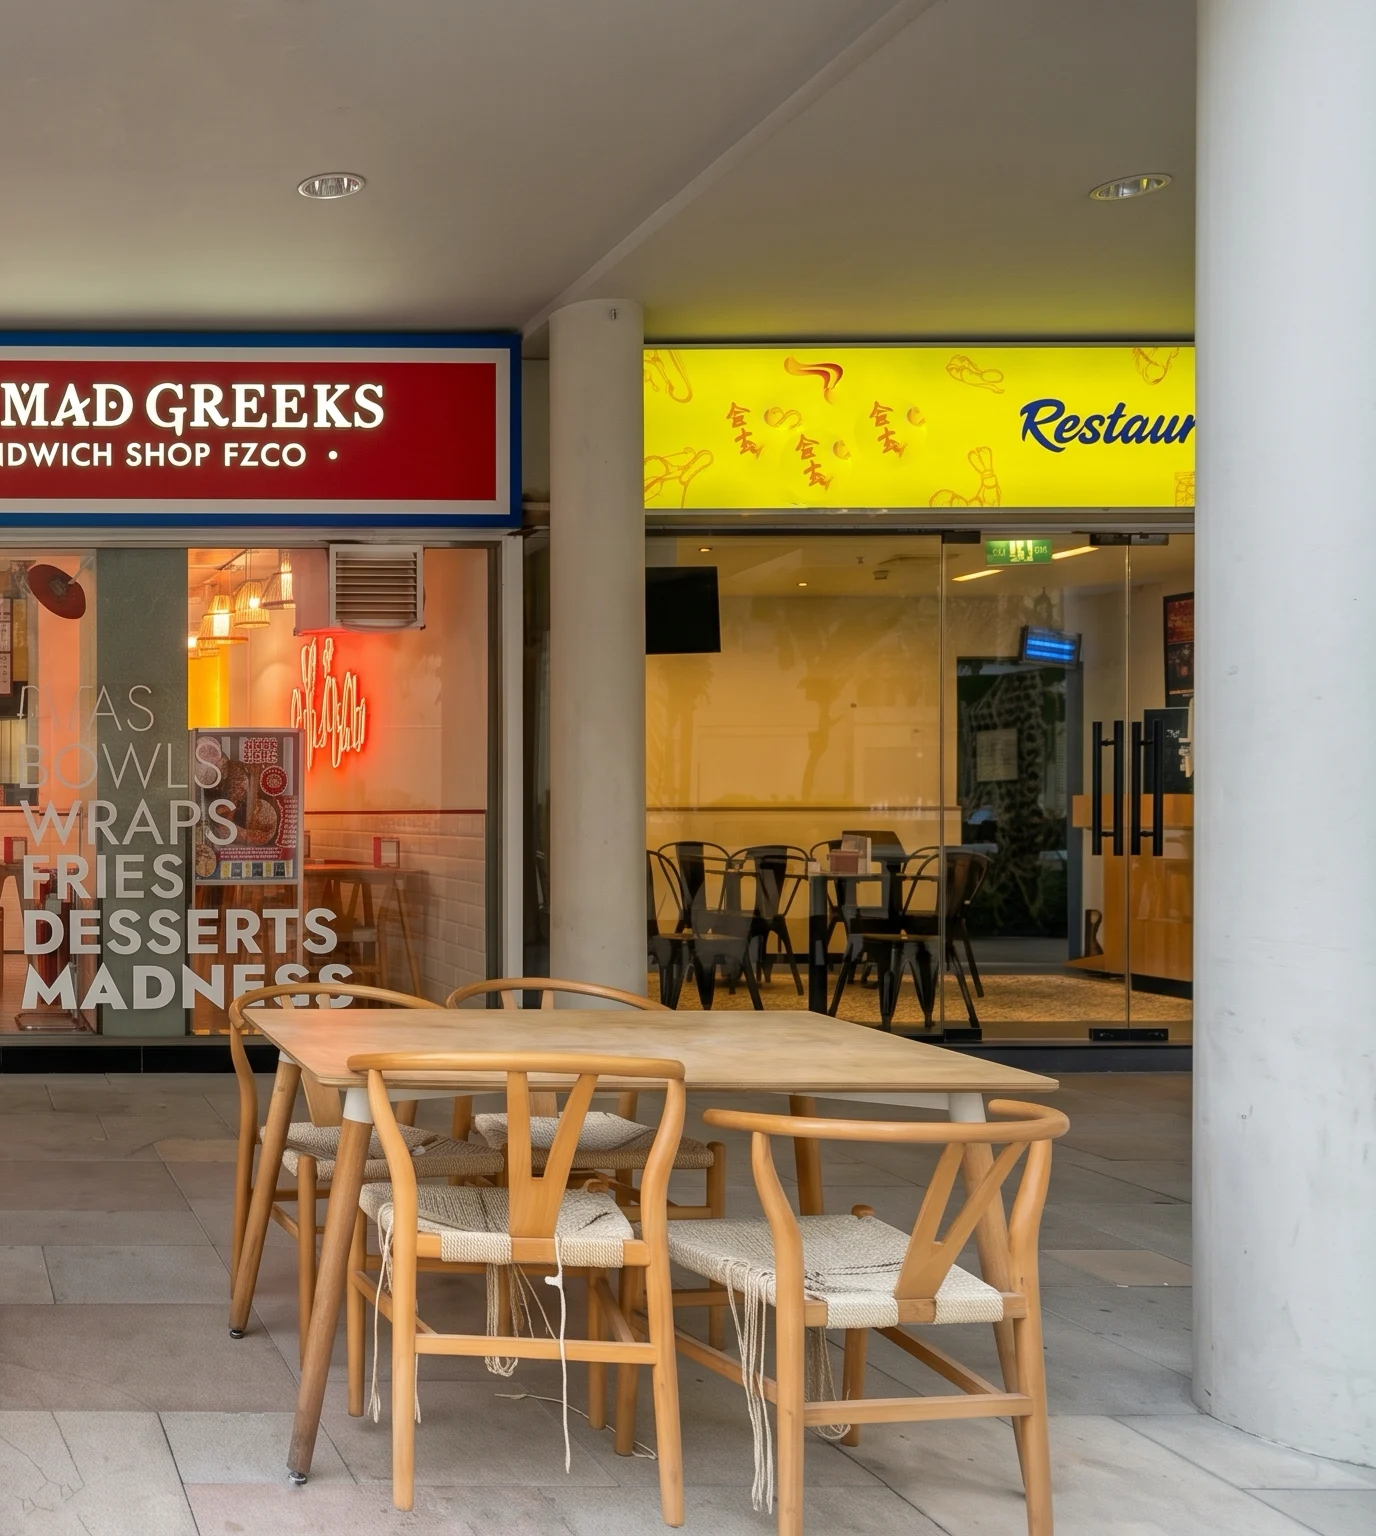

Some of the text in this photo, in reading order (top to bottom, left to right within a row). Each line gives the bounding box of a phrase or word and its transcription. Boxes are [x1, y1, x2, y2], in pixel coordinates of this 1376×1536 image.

[0, 382, 134, 427] MAD
[145, 382, 384, 437] GREEKS
[125, 442, 211, 467] SHOP
[224, 442, 307, 467] FZCO
[19, 743, 222, 790] BOWLS
[20, 799, 238, 846] WRAPS
[24, 853, 184, 900] FRIES
[23, 908, 338, 955] DESSERTS
[21, 963, 354, 1010] MADNESS
